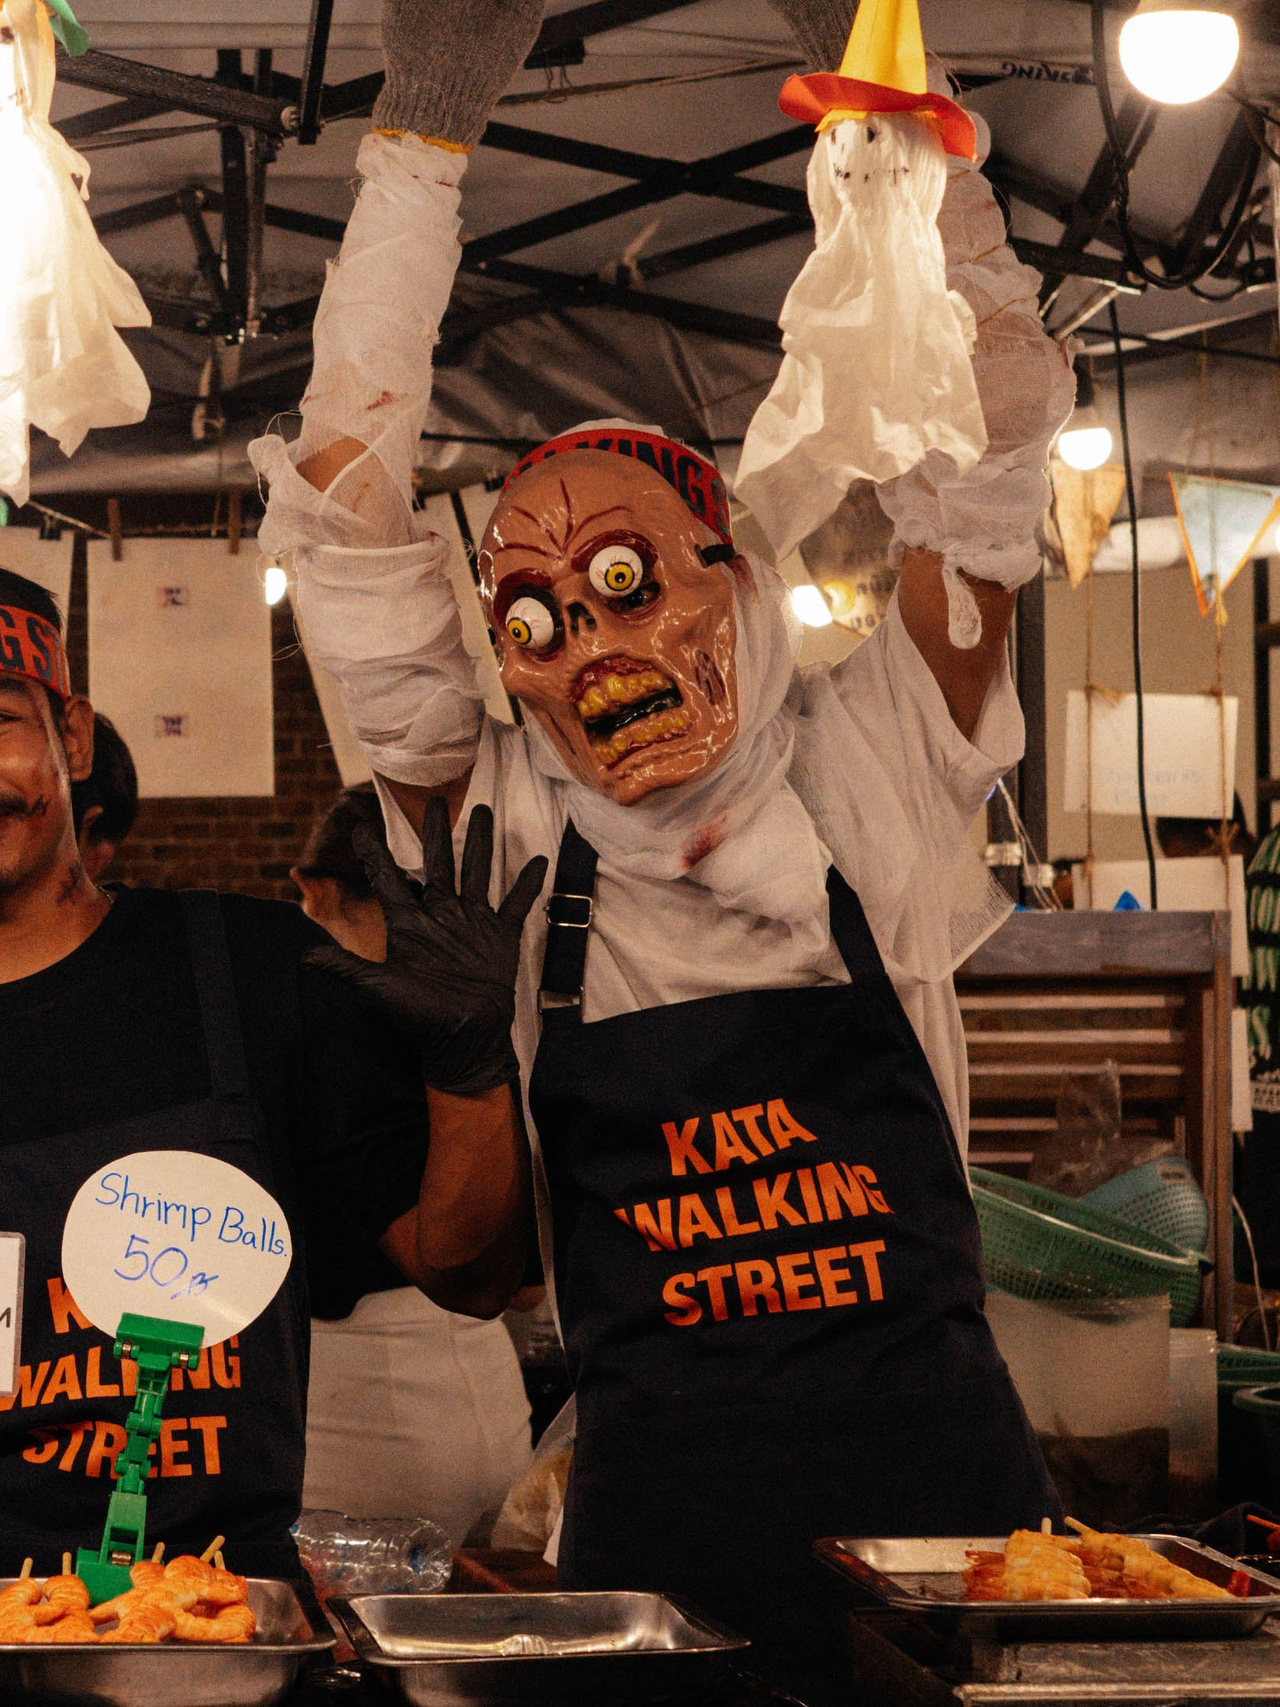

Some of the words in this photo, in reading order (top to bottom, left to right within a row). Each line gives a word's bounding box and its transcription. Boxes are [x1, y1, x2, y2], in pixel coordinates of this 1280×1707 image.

[661, 1098, 818, 1177] KATA
[95, 1172, 212, 1242] Shrimp
[613, 1161, 896, 1252] WALKING
[662, 1239, 887, 1327] STREET
[22, 1415, 228, 1480] STRET
